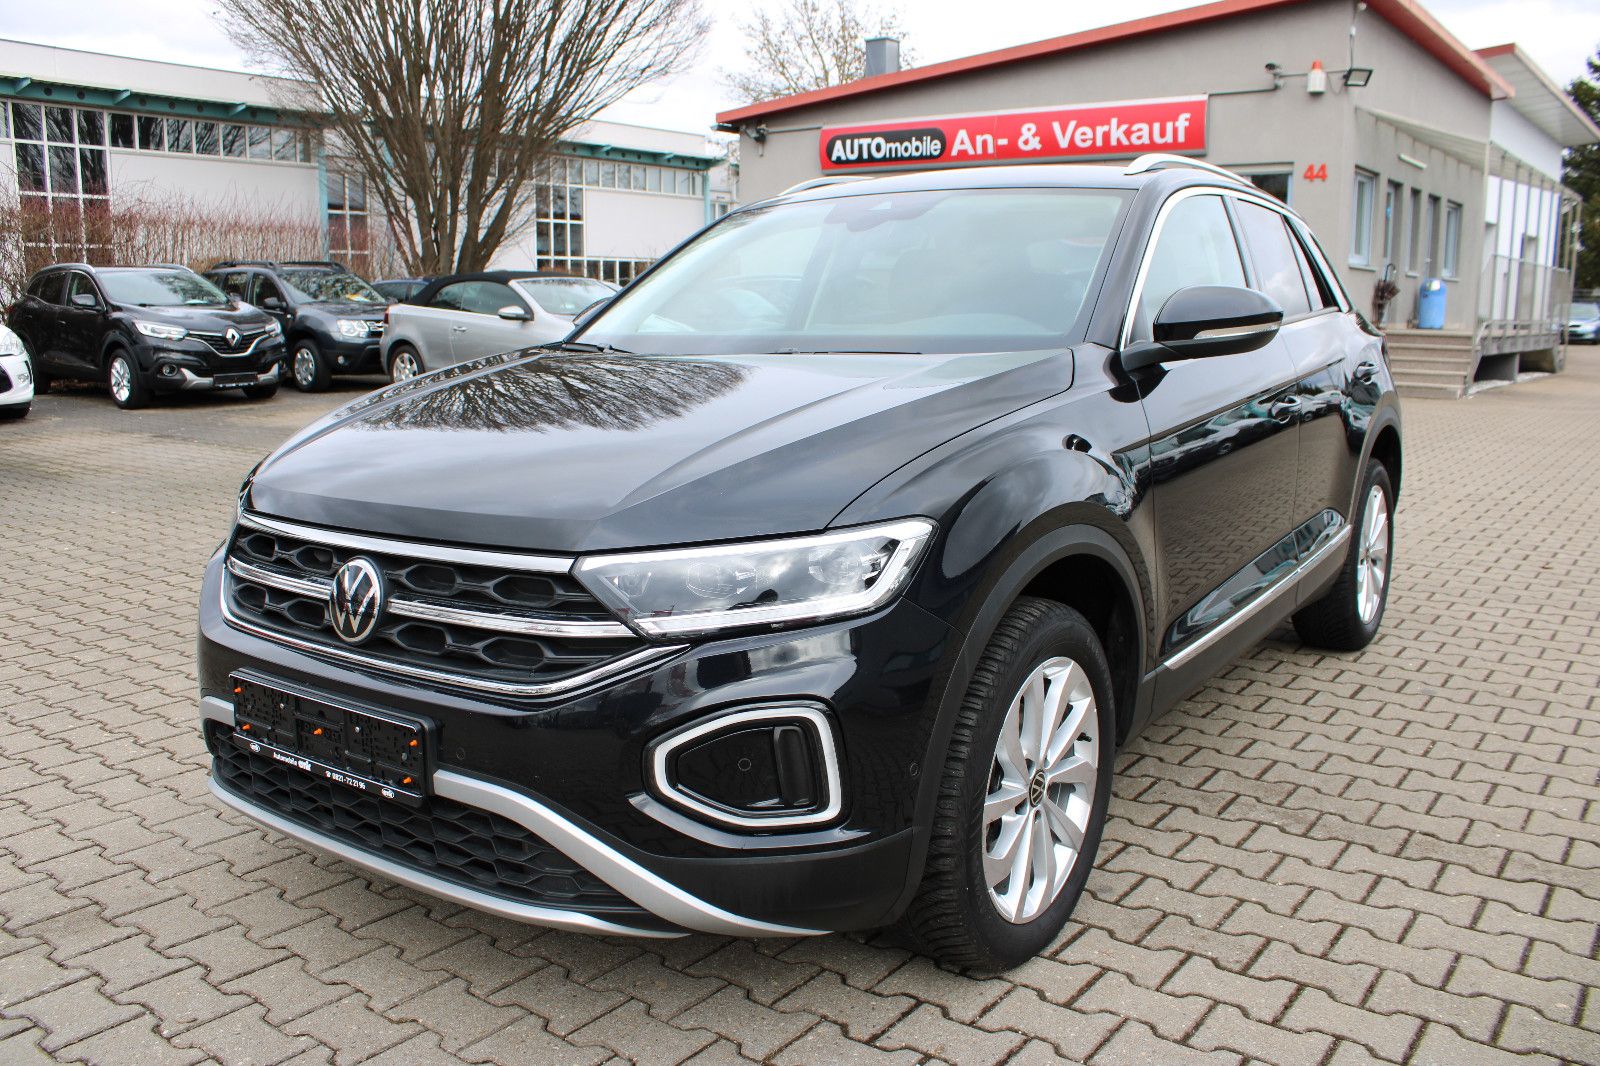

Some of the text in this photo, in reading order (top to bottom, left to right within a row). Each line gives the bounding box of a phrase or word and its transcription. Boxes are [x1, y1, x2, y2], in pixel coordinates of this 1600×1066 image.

[831, 112, 1191, 162] AUTOmobile An- & Verkauf
[1303, 163, 1328, 182] 44
